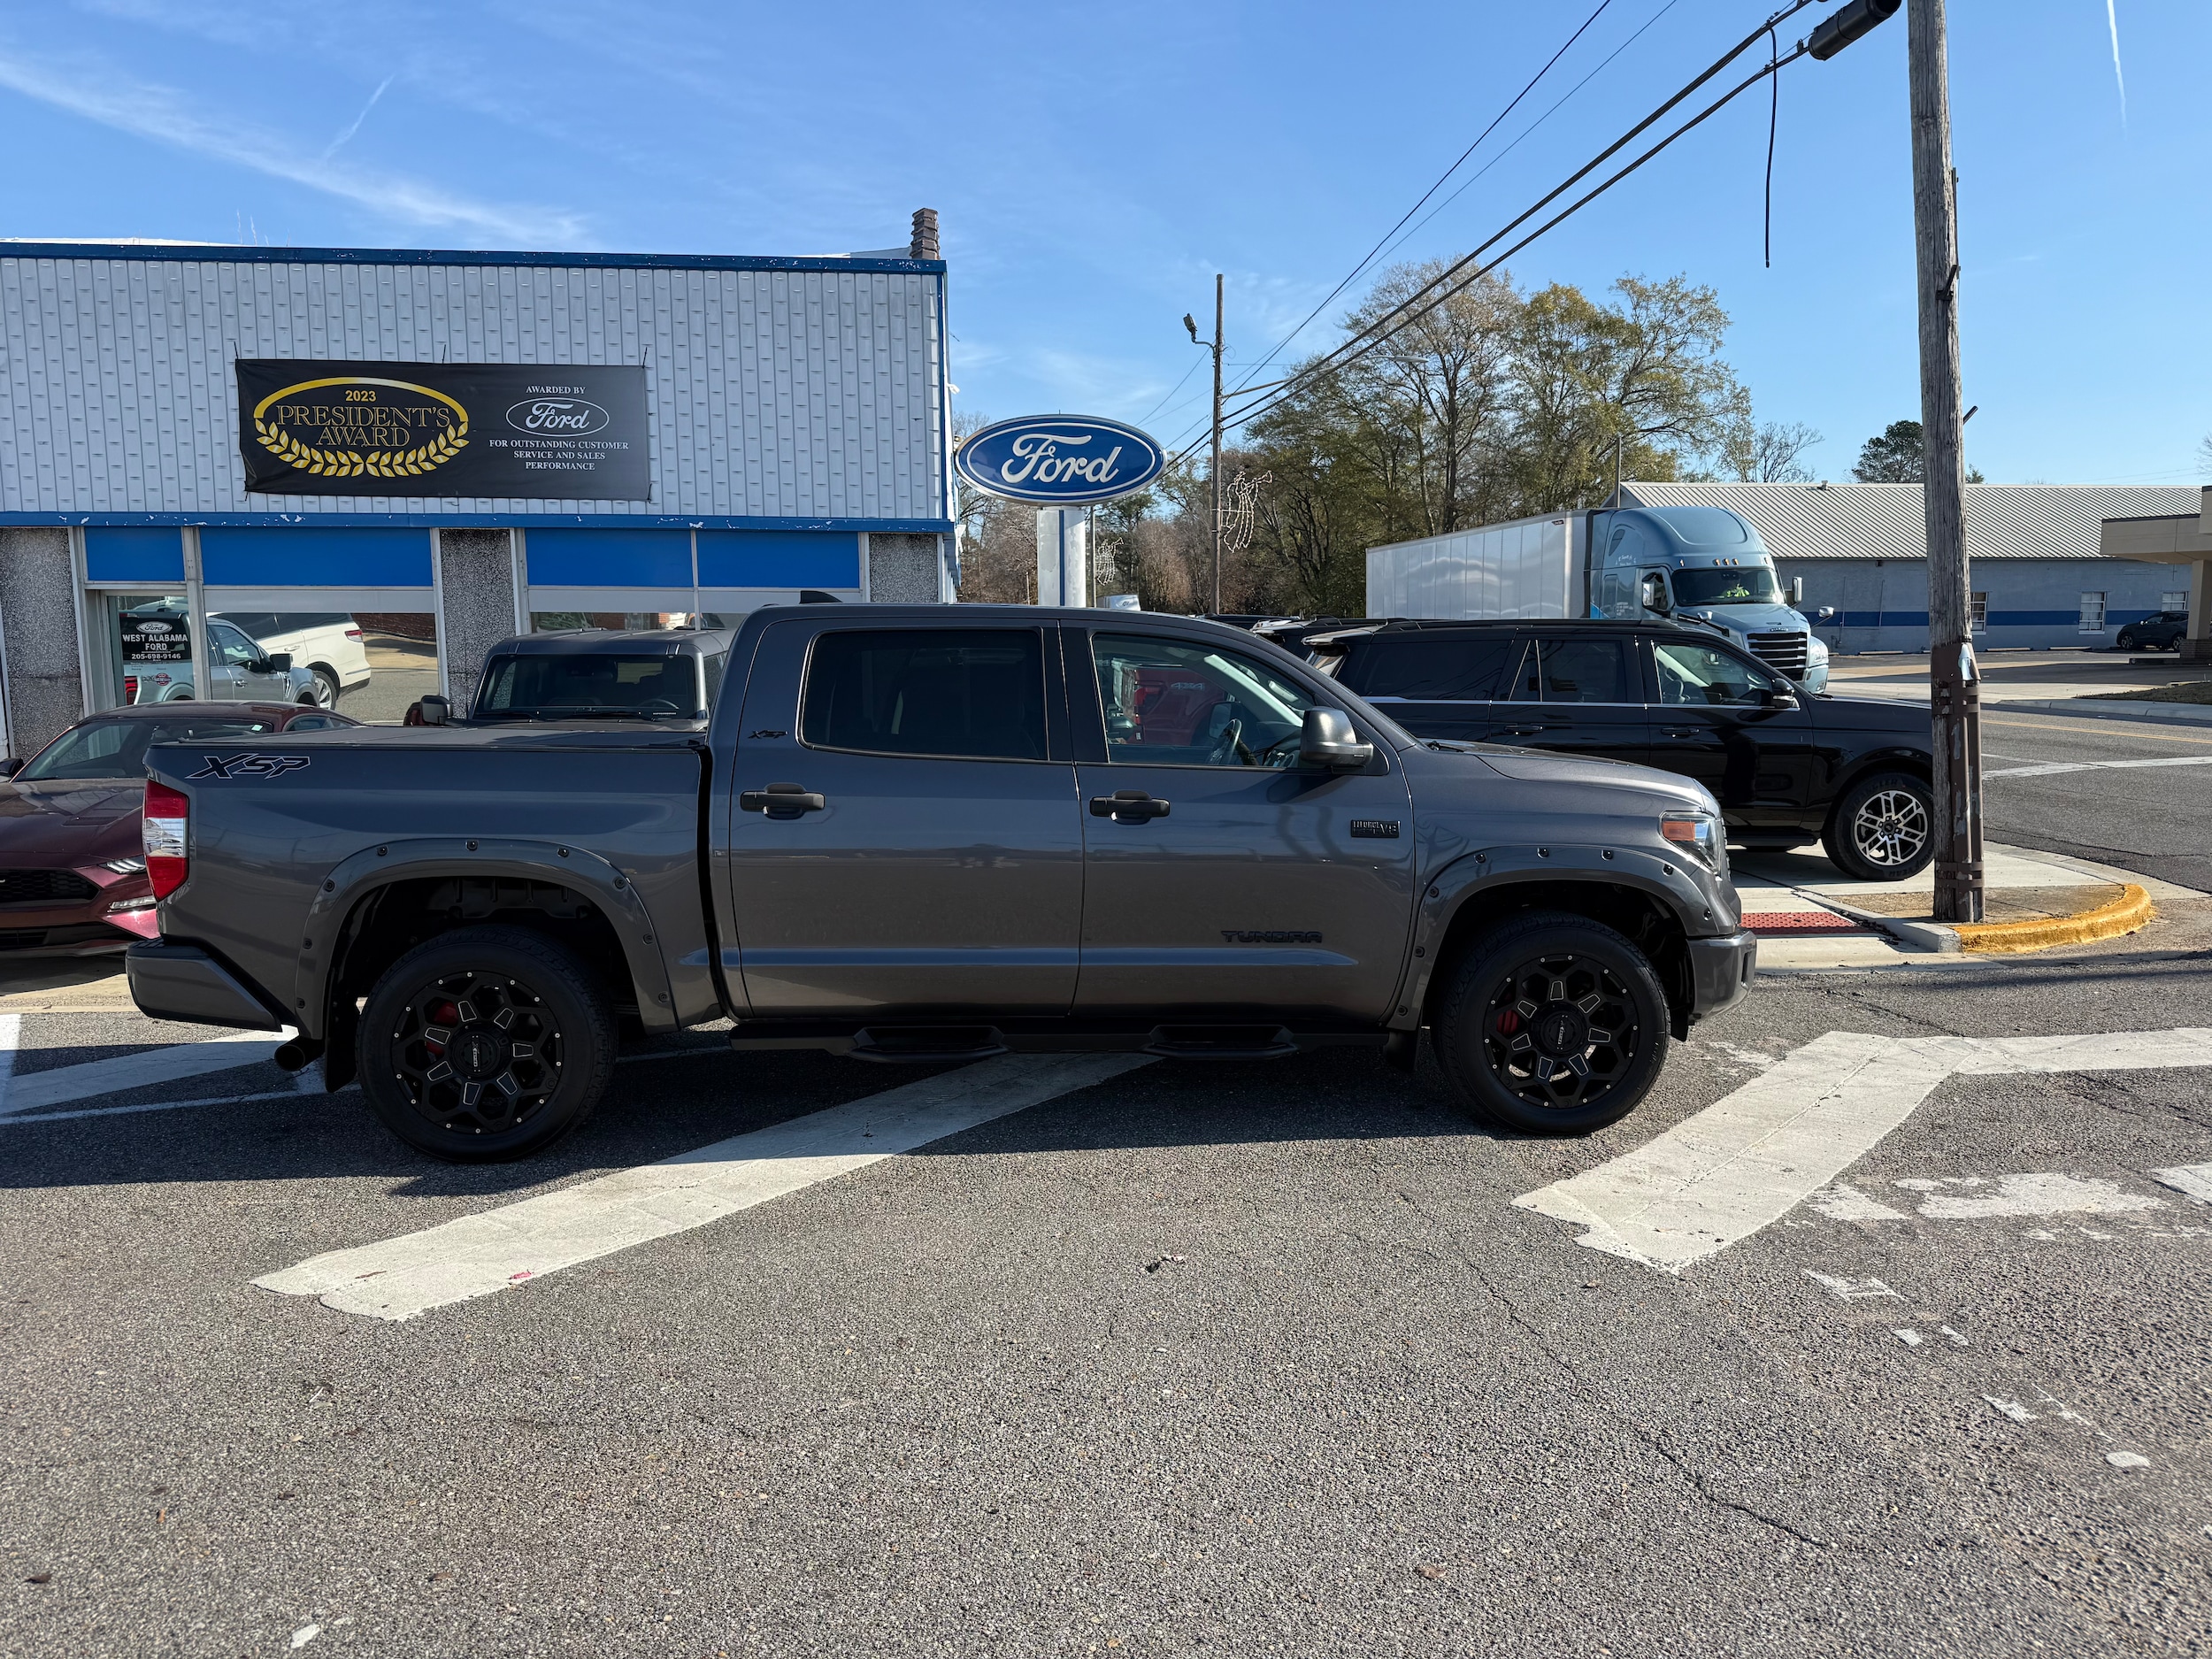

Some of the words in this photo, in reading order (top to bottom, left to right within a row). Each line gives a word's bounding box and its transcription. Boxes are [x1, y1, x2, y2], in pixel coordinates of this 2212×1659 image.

[345, 390, 376, 402] 2023
[526, 386, 571, 395] AWARDED
[276, 405, 450, 427] PRESIDENT'S
[526, 402, 590, 429] Ford
[315, 426, 411, 447] AWARD
[511, 440, 576, 449] OUTSTANDING
[525, 462, 595, 471] PERFORMANCE
[1001, 433, 1123, 483] Ford
[184, 753, 311, 779] XSP
[1221, 930, 1323, 944] TUNDRA
